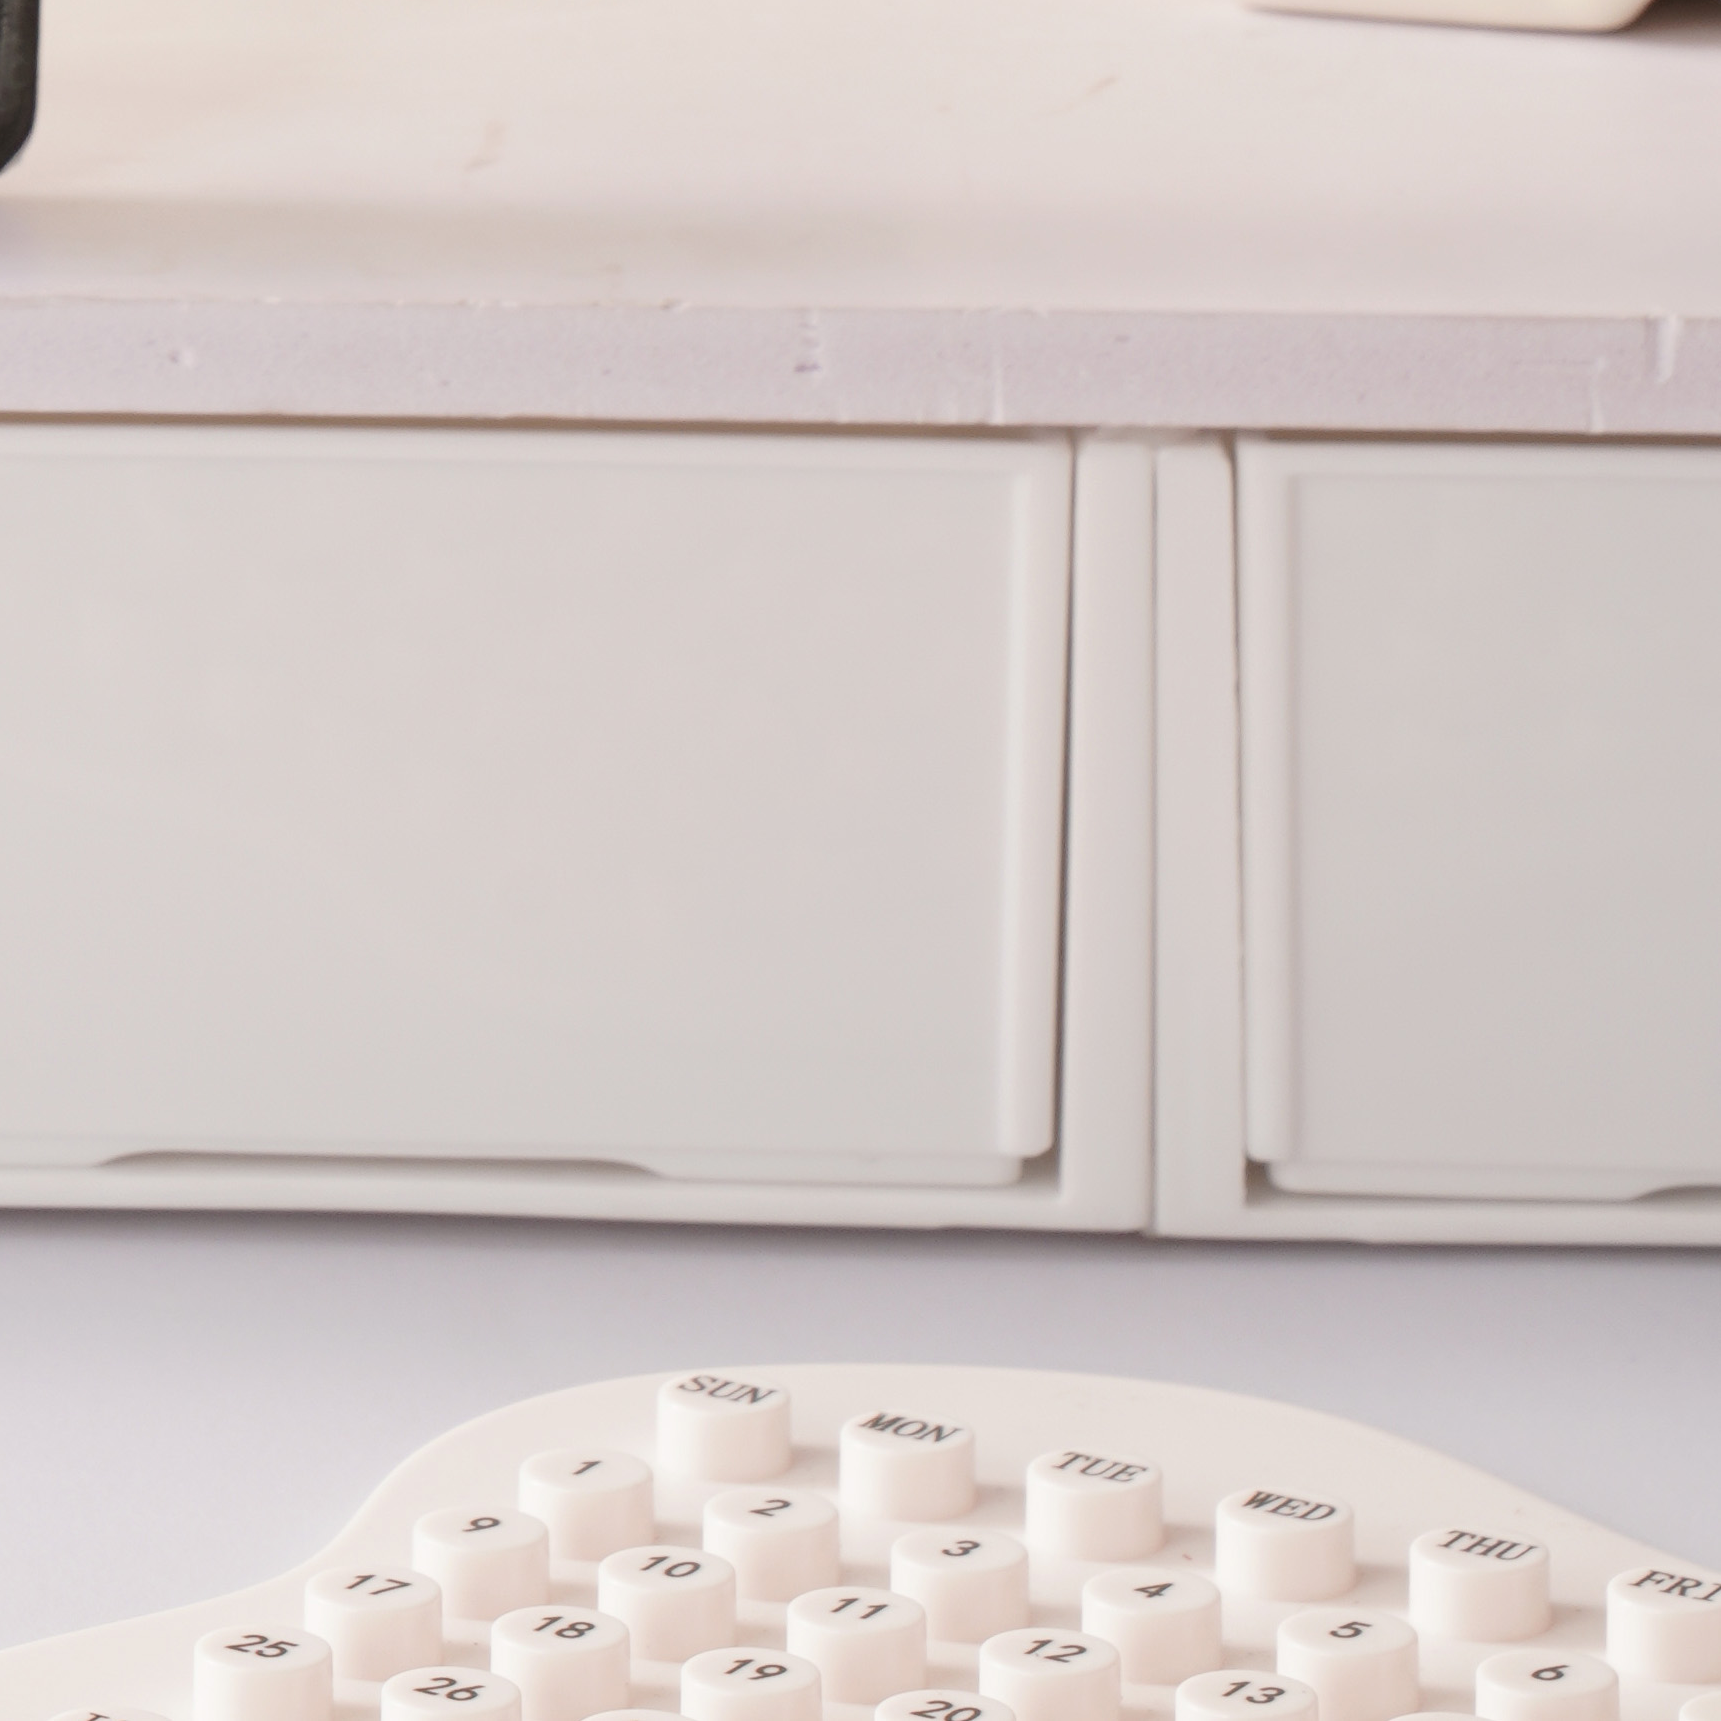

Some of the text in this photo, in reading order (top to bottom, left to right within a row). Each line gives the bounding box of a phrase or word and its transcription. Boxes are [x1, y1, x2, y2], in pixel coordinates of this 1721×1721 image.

[677, 1374, 776, 1405] SUN
[858, 1412, 963, 1443] MON
[572, 1460, 602, 1475] 1
[1052, 1451, 1148, 1483] TUE
[749, 1498, 792, 1517] 2
[1242, 1490, 1337, 1522] WED
[462, 1516, 501, 1533] 9
[941, 1539, 981, 1557] 3
[1439, 1529, 1539, 1562] THU
[640, 1555, 702, 1579] 10
[344, 1573, 414, 1597] 17
[1133, 1582, 1175, 1599] 4
[1629, 1569, 1721, 1603] FRI
[830, 1596, 890, 1620] 11
[532, 1615, 597, 1640] 18
[1329, 1620, 1372, 1639] 5
[225, 1634, 300, 1659] 25
[1023, 1638, 1087, 1663] 12
[723, 1658, 789, 1681] 19
[1531, 1664, 1571, 1682] 6
[413, 1676, 487, 1703] 26
[1220, 1680, 1287, 1705] 13
[908, 1699, 983, 1721] 20
